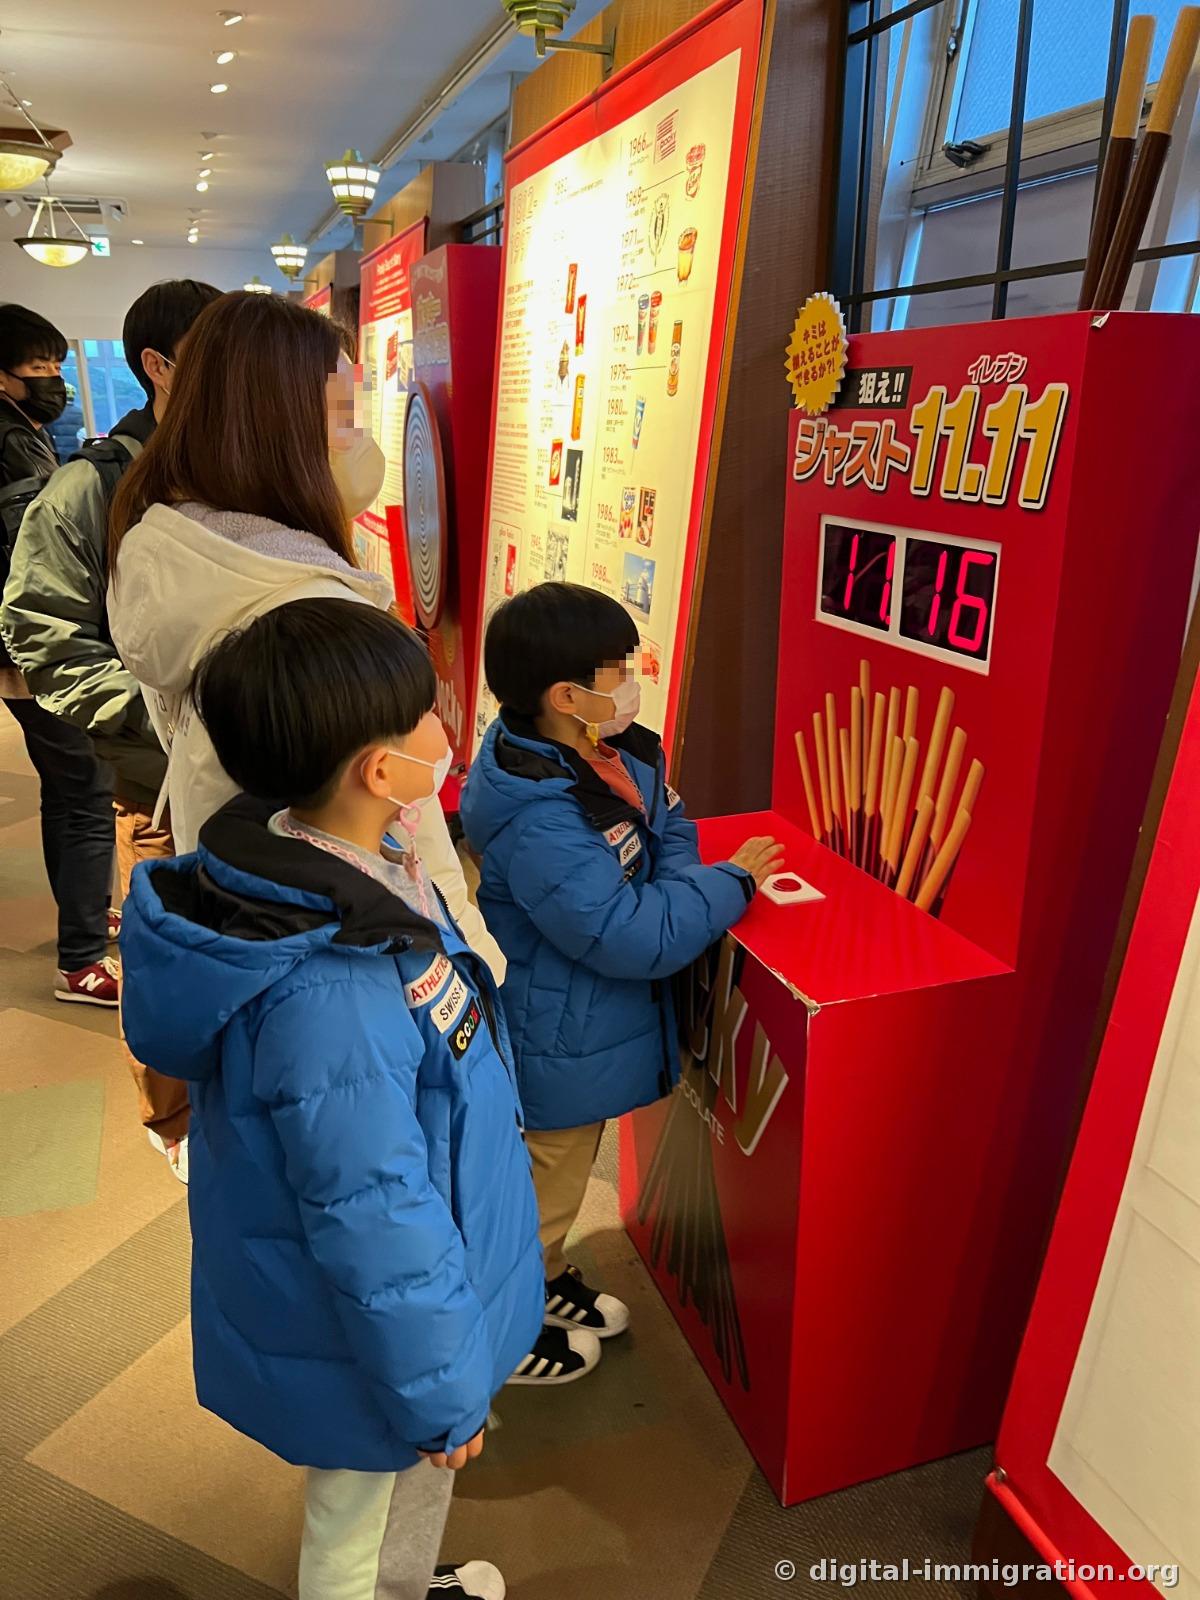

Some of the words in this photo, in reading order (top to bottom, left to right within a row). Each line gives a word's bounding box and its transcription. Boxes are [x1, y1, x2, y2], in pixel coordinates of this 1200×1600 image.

[629, 132, 647, 158] 1966
[967, 352, 1027, 384] イレブン
[607, 399, 623, 415] 1980
[603, 447, 619, 464] 1983
[597, 503, 613, 522] 1986
[682, 1078, 725, 1146] COLATE
